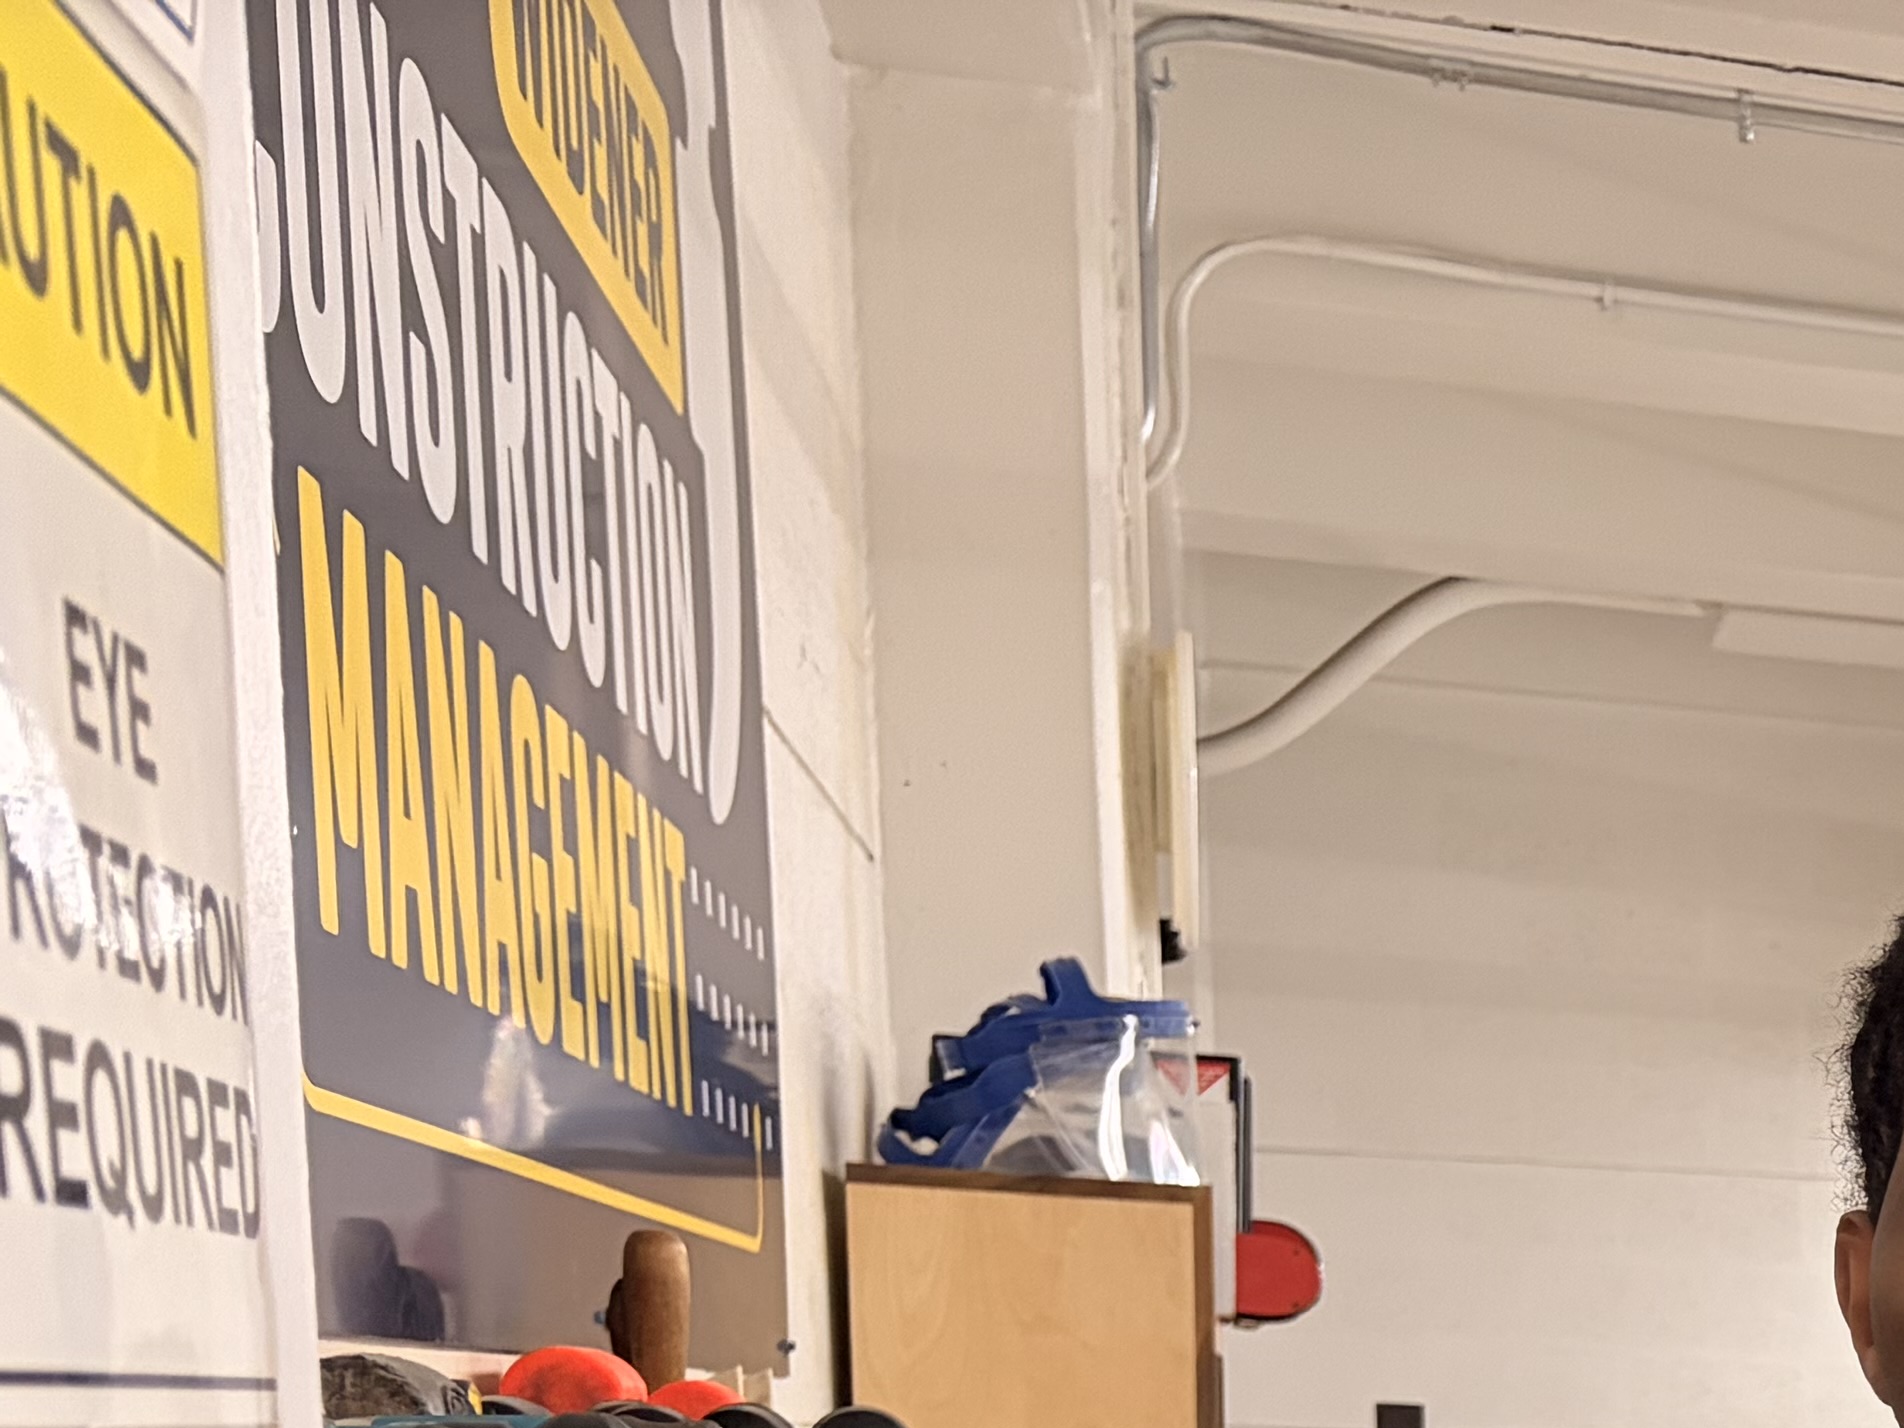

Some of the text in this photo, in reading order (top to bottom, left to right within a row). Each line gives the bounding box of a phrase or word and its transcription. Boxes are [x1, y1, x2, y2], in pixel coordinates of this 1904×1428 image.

[0, 62, 196, 440] UTION
[255, 0, 703, 794] ONSTRUCTION
[64, 597, 158, 784] EYE
[297, 465, 694, 1117] MANAGEMENT
[1, 806, 250, 1027] ROTECTION
[0, 1016, 261, 1239] REQUIRED
